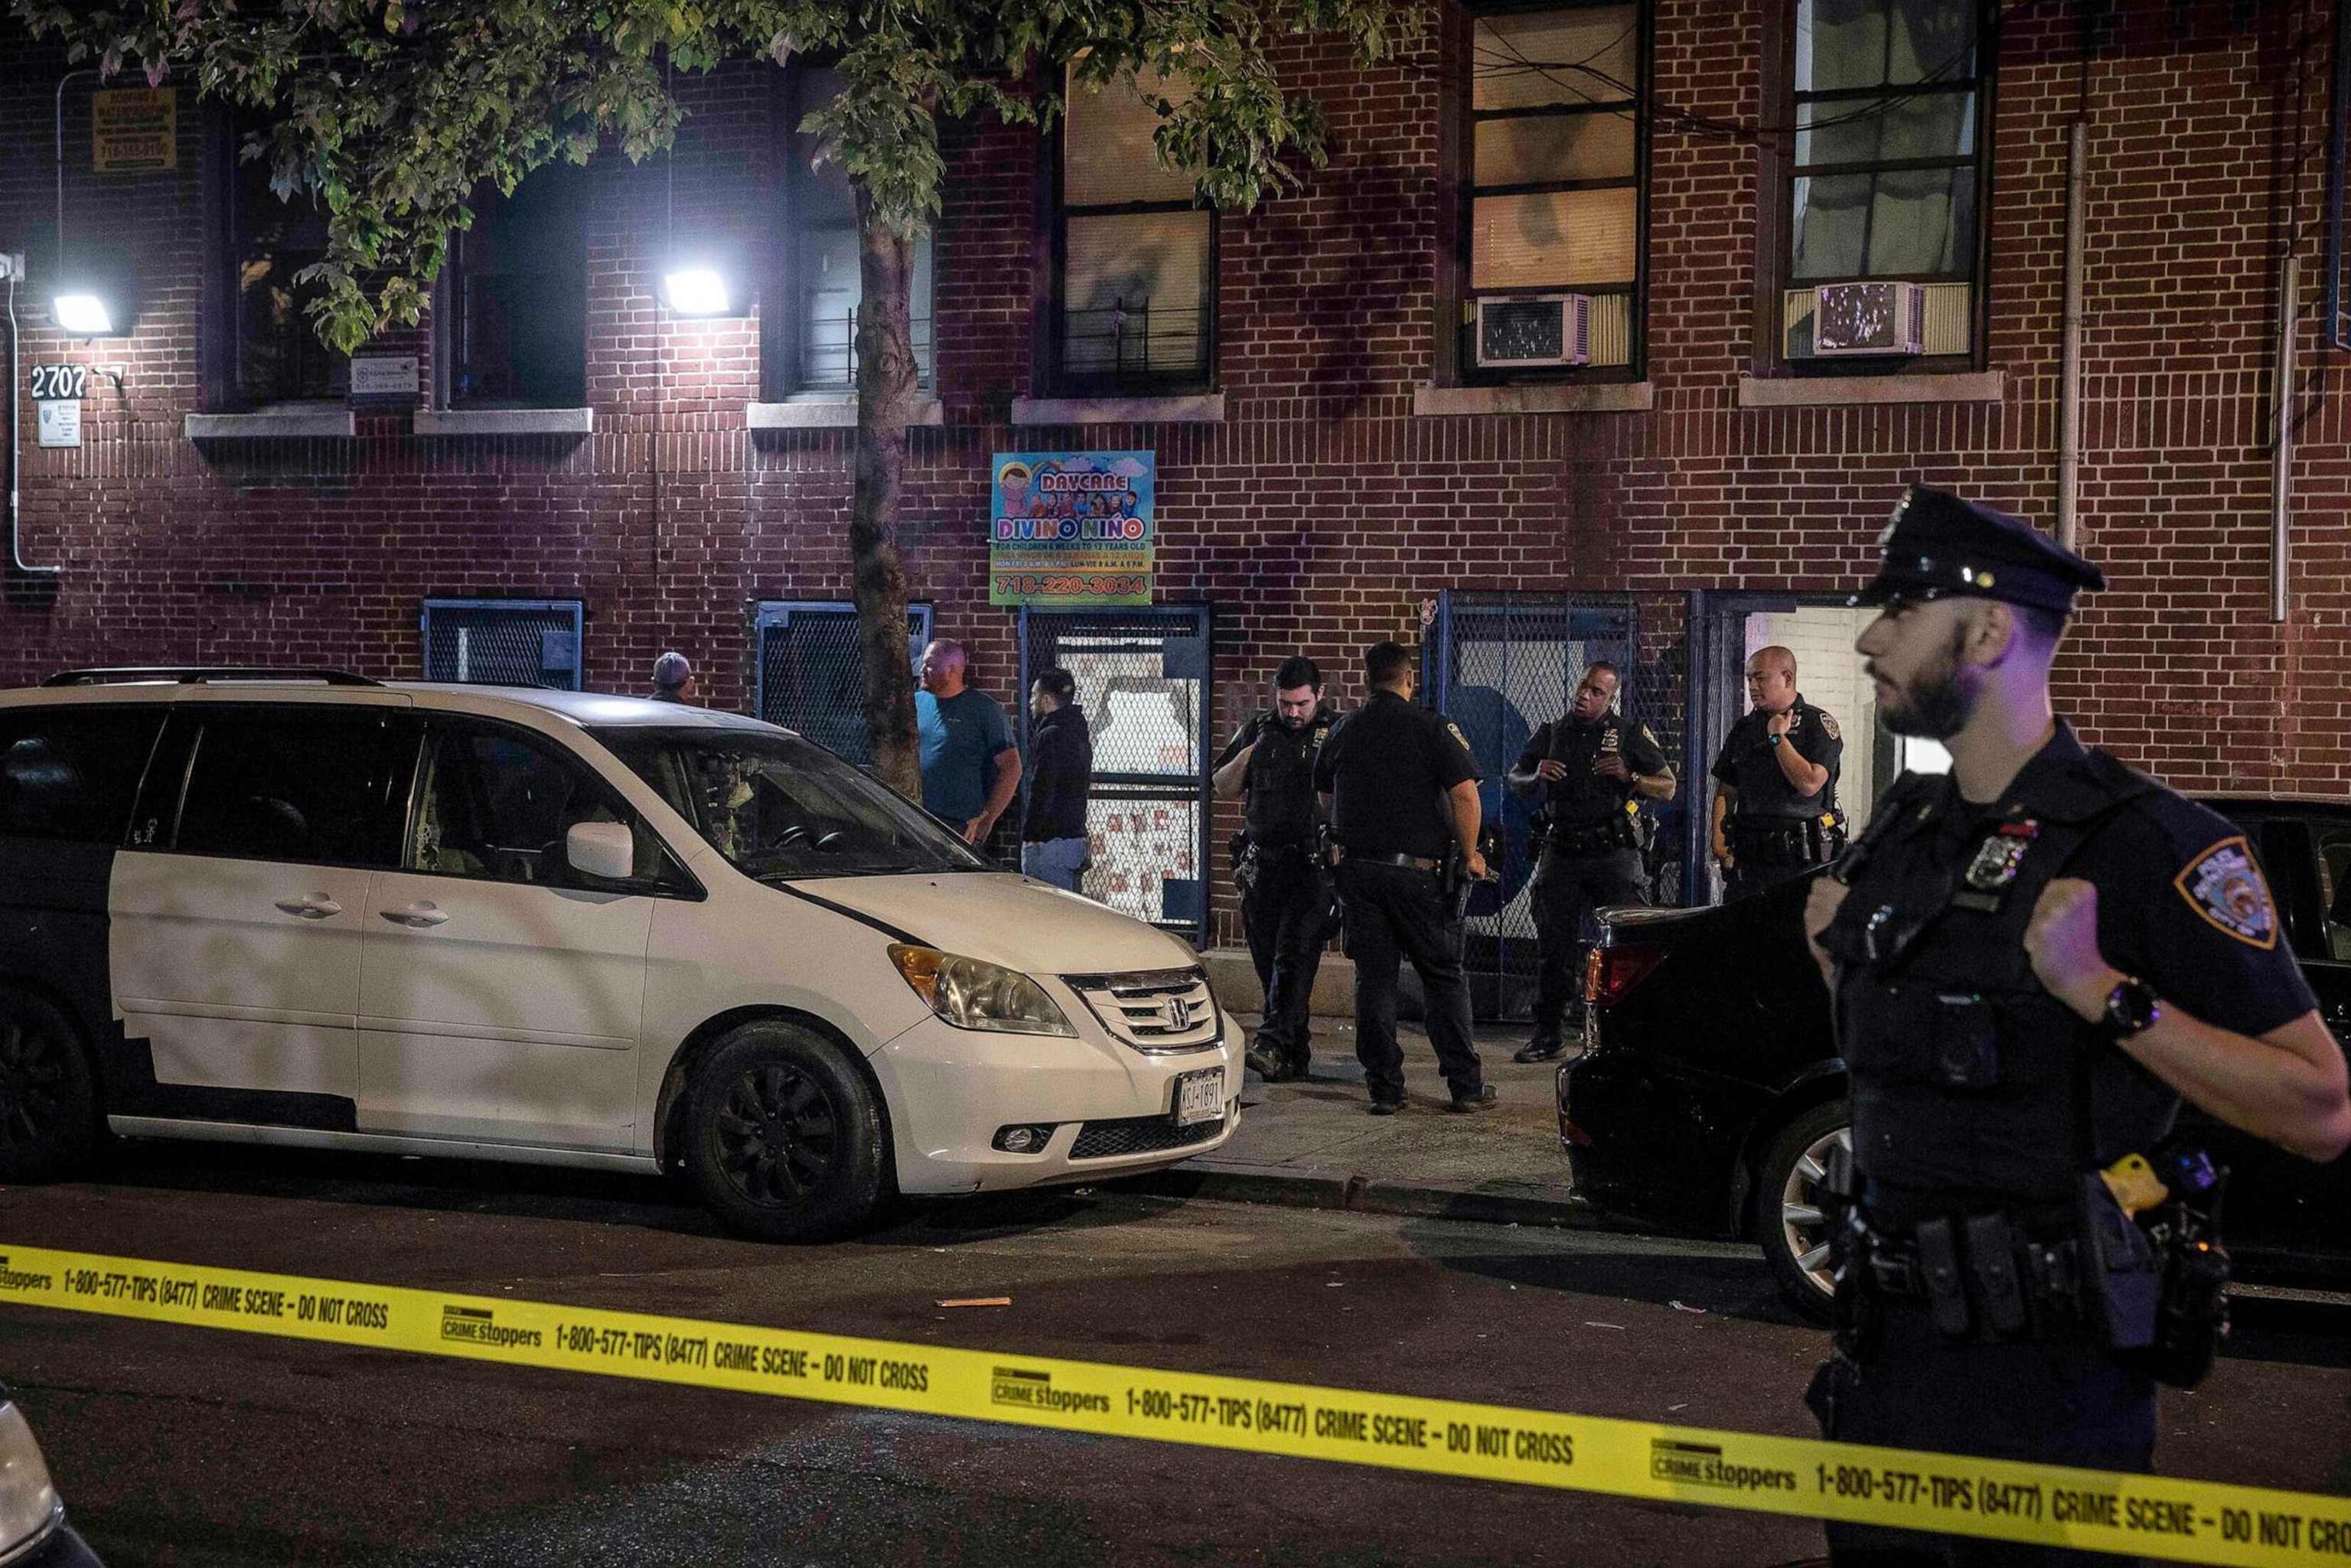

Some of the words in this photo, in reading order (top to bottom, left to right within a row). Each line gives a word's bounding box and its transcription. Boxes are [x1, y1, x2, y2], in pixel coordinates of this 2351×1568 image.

[31, 366, 86, 397] 2707
[1041, 473, 1129, 491] DAYCARE
[997, 517, 1078, 540] DIVINO
[1081, 513, 1145, 540] NIÑO
[996, 543, 1010, 551] FOR
[1012, 543, 1048, 551] CHILDREN
[1055, 543, 1080, 551] WEEKS
[1083, 543, 1092, 551] TO
[1094, 543, 1102, 551] 12
[1103, 543, 1128, 551] YEARS
[1130, 543, 1146, 551] OLD
[996, 576, 1146, 594] 718-220-3034
[0, 1266, 52, 1291] toppers
[64, 1268, 157, 1302] 1-800-577-TIPS
[159, 1276, 198, 1309] (8477)
[202, 1284, 242, 1312] CRIME
[243, 1289, 285, 1317] SCENE
[298, 1294, 316, 1321] DO
[318, 1296, 344, 1324] NOT
[346, 1299, 389, 1329] CROSS
[444, 1321, 478, 1339] CRIME
[479, 1322, 542, 1348] stoppers
[556, 1322, 663, 1361] 1-800-577-TIPS
[664, 1332, 708, 1369] (8477)
[713, 1341, 759, 1372] CRIME
[762, 1347, 807, 1377] SCENE
[824, 1353, 843, 1382] DO
[848, 1356, 877, 1385] NOT
[879, 1360, 928, 1392] CROSS
[994, 1384, 1032, 1403] CRIME
[1035, 1384, 1110, 1413] stoppers
[1126, 1387, 1252, 1429] 1-800-577-TIPS
[1256, 1397, 1306, 1438] (8477)
[1314, 1409, 1368, 1441] CRIME
[1372, 1414, 1427, 1448] SCENE
[1447, 1422, 1471, 1454] DO
[1476, 1424, 1511, 1459] NOT
[1515, 1429, 1574, 1465] CROSS
[1704, 1459, 1797, 1491] stoppers
[1816, 1462, 1972, 1510] 1-800-577-TIPS
[1977, 1476, 2043, 1522] (8477)
[2052, 1488, 2118, 1527] CRIME
[2125, 1495, 2196, 1536] SCENE
[2221, 1507, 2252, 1542] DO
[2258, 1510, 2303, 1549] NOT
